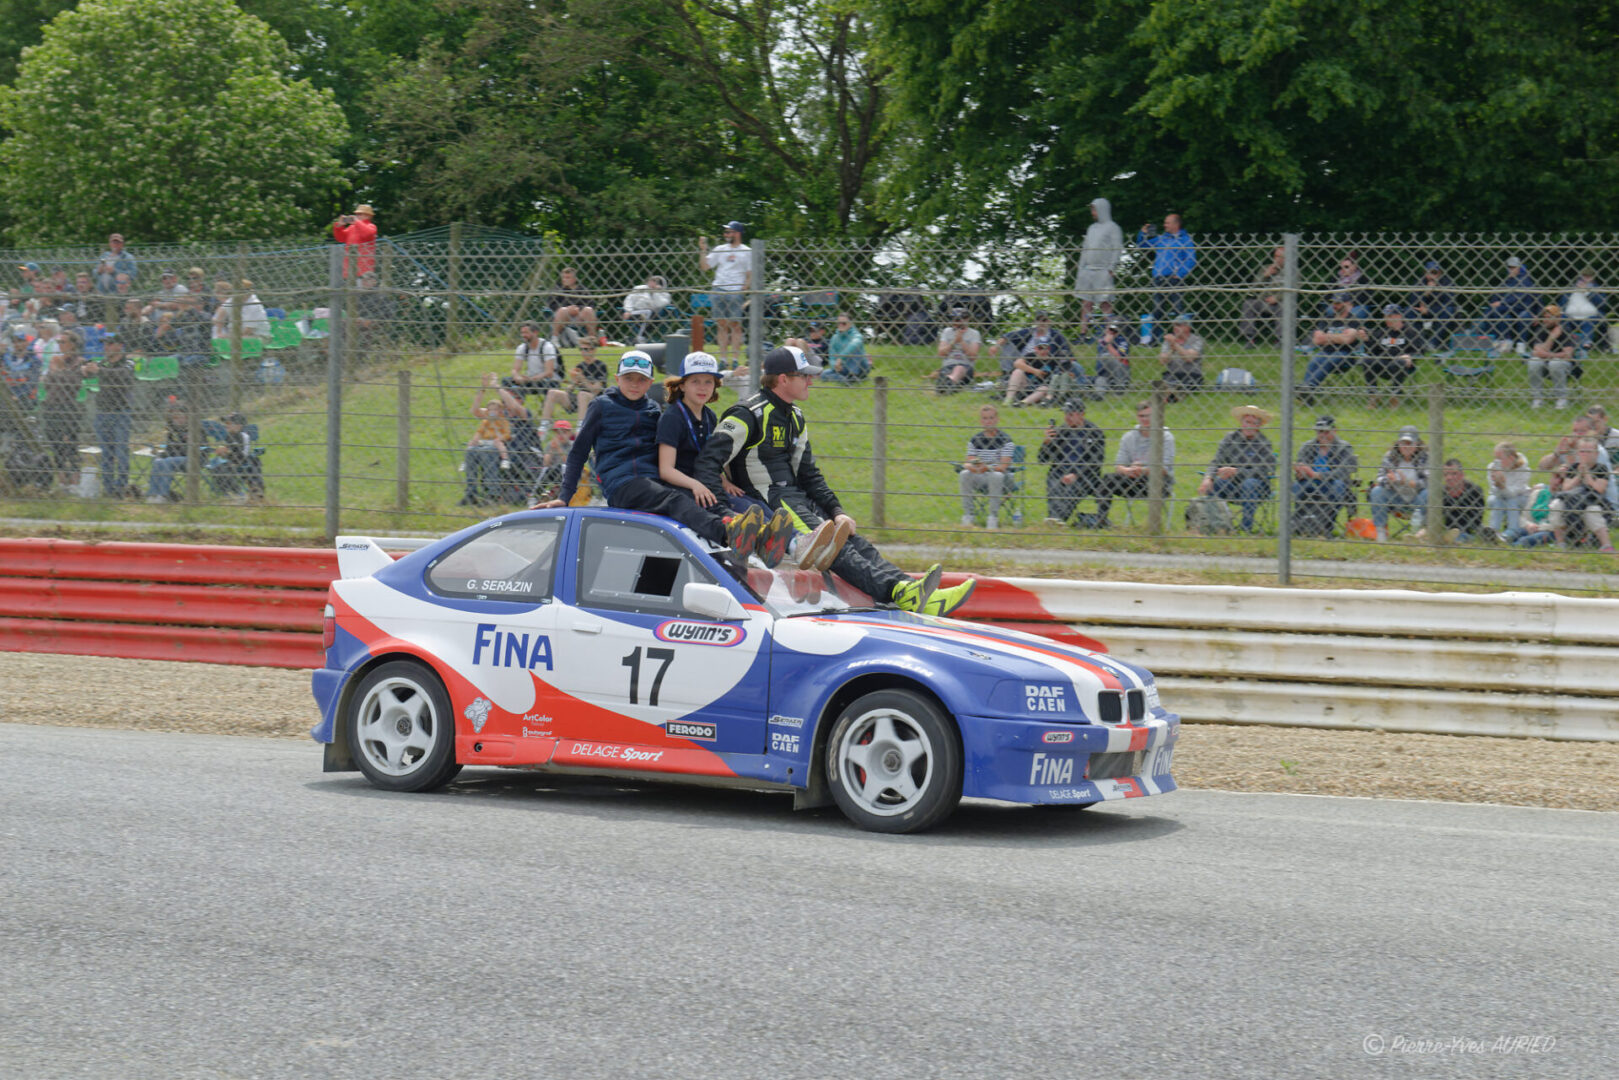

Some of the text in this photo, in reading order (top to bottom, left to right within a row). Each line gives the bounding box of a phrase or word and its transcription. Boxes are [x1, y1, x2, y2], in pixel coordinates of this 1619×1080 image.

[466, 579, 533, 593] G. SERAZIN
[472, 623, 554, 671] FINA
[621, 646, 675, 706] 17
[1025, 685, 1065, 697] DAF
[1026, 697, 1066, 712] CAEN
[669, 724, 713, 737] FERODO
[772, 732, 800, 743] DAF
[571, 743, 665, 761] DELAGE Sport
[771, 740, 800, 753] CAEN
[1029, 753, 1074, 785] FINA
[1071, 789, 1092, 798] Sport
